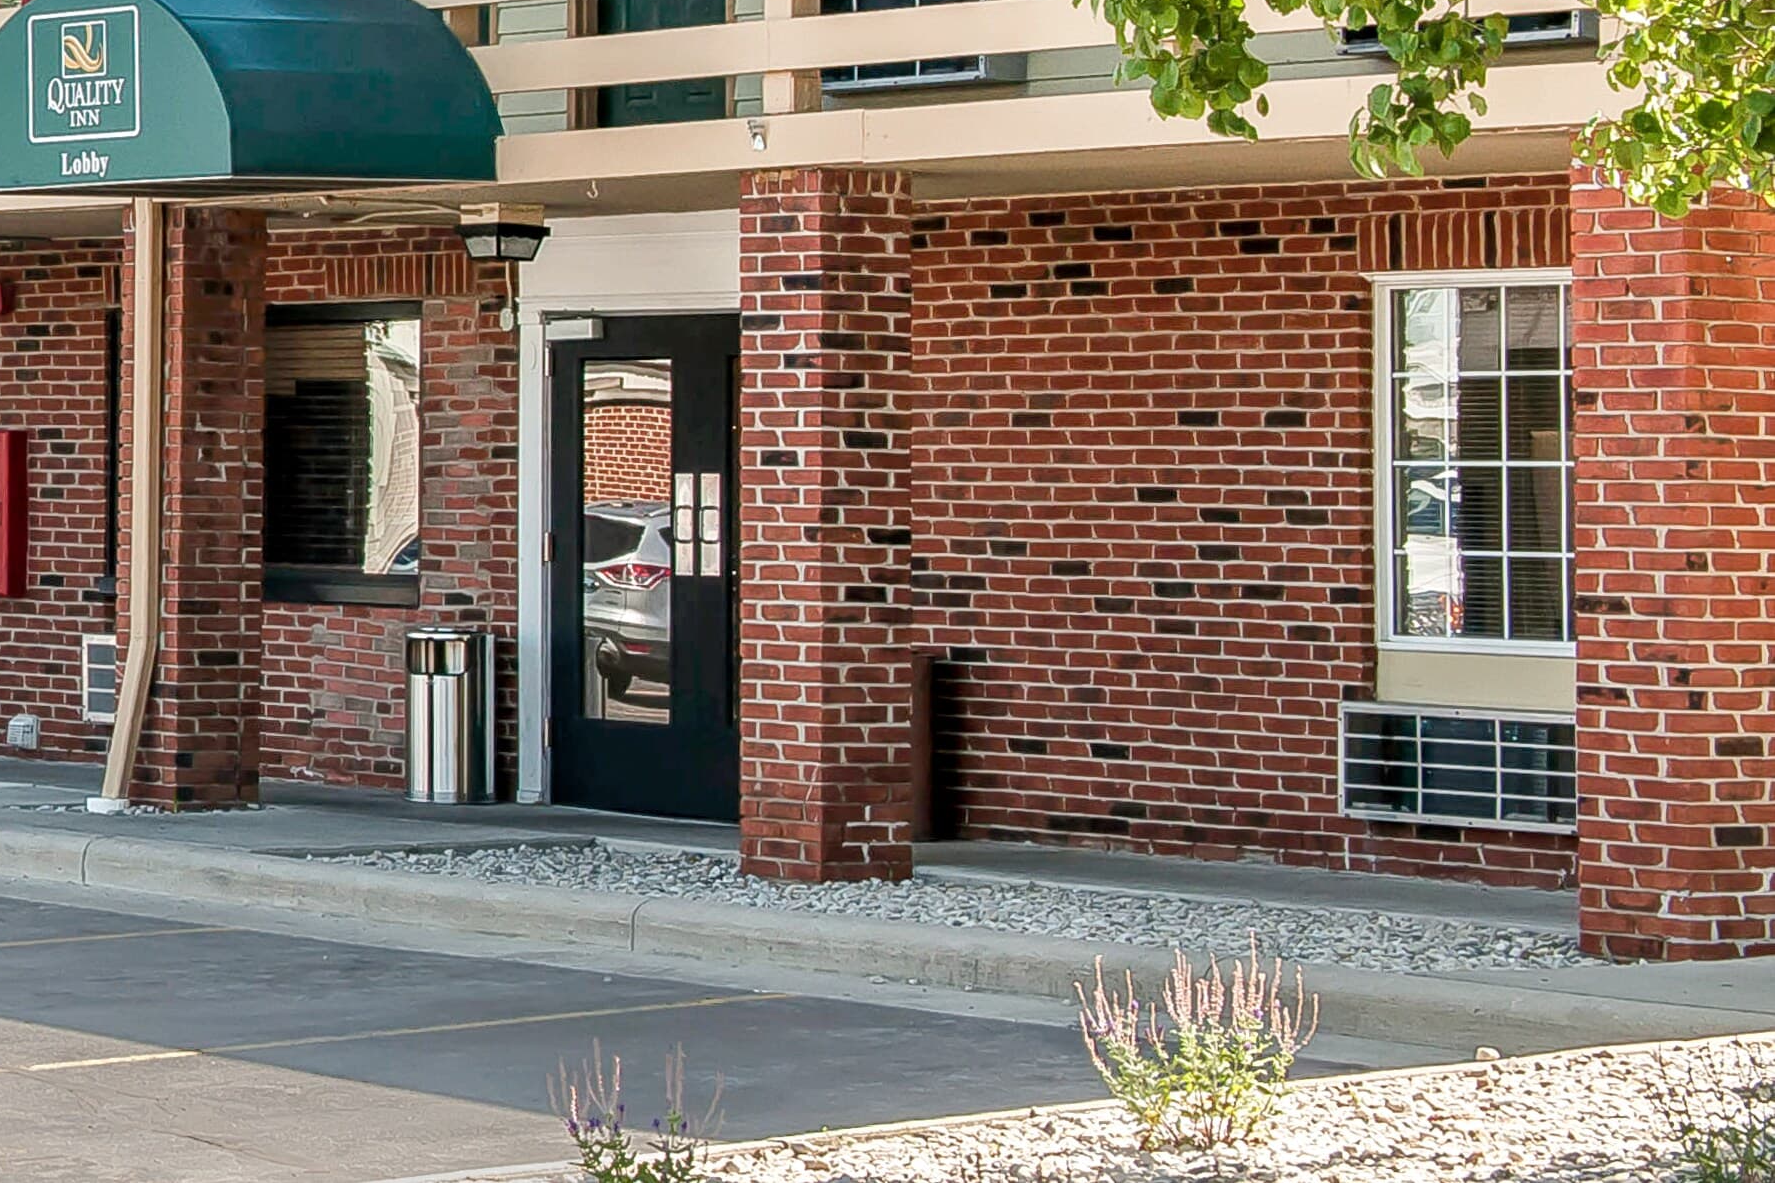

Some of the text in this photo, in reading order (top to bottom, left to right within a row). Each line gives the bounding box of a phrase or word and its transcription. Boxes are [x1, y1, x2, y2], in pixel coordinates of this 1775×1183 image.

[47, 77, 125, 114] QUALITY
[69, 109, 101, 127] INN
[61, 151, 110, 178] Lobby
